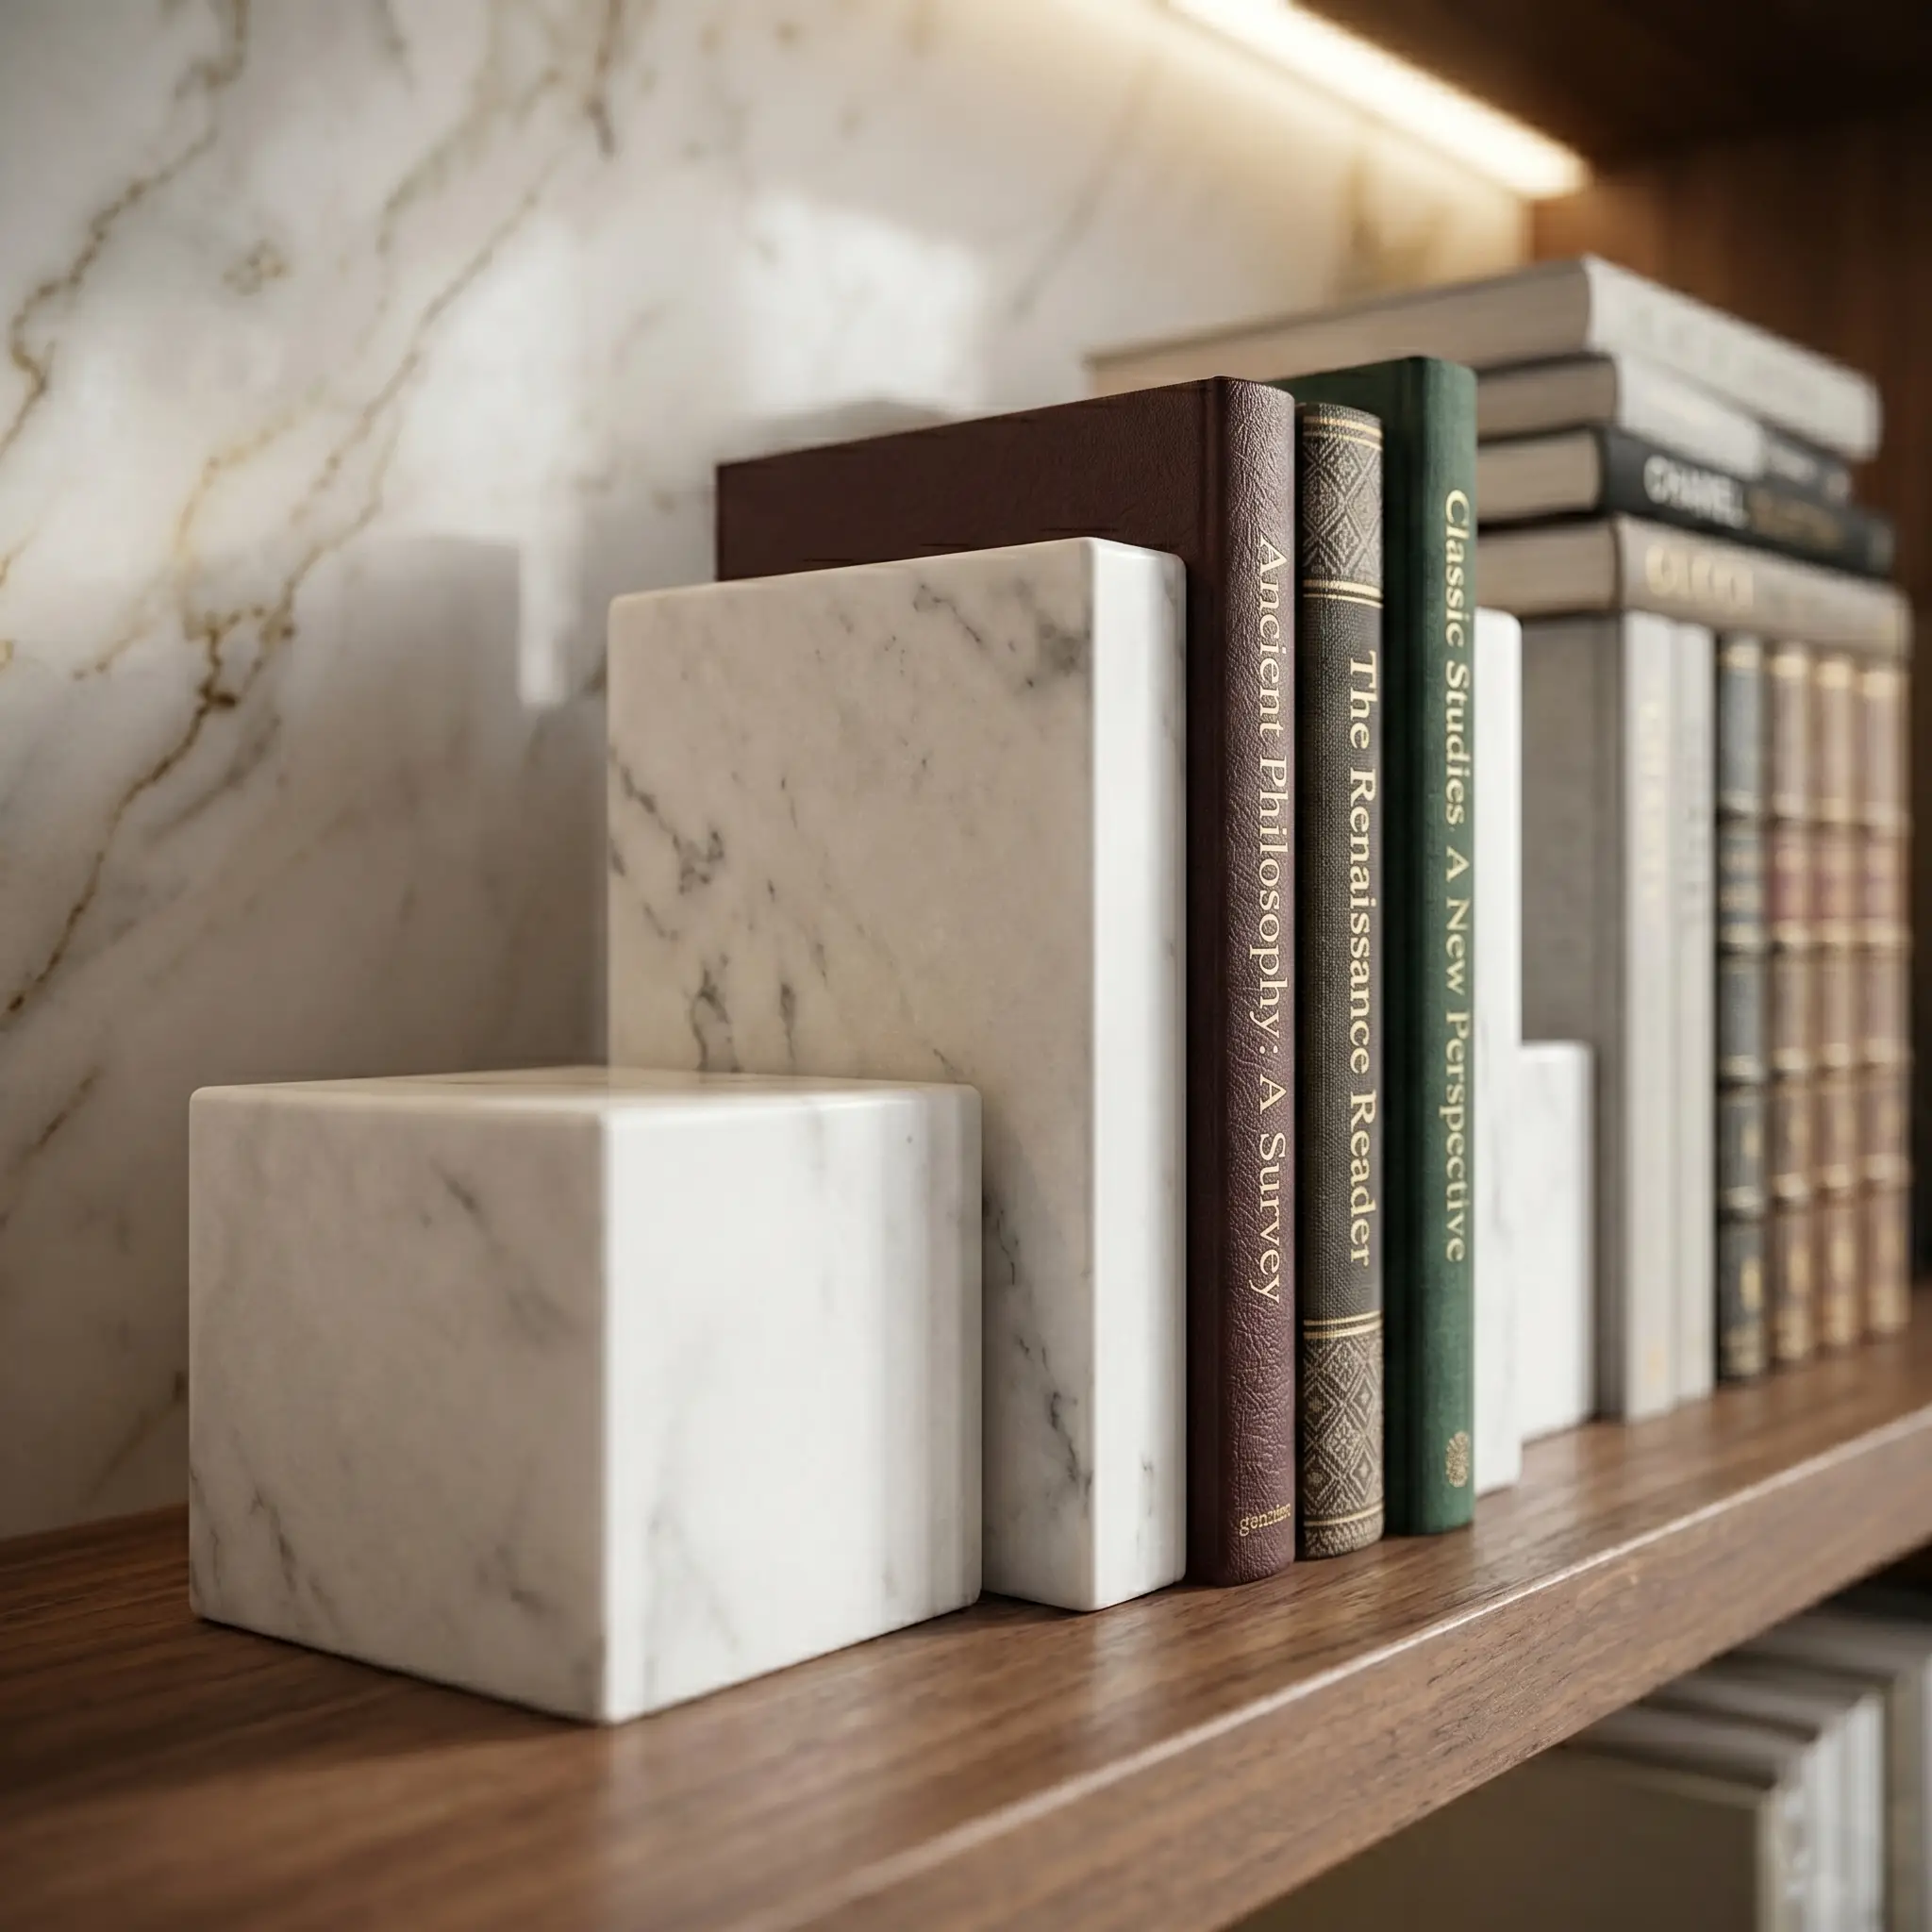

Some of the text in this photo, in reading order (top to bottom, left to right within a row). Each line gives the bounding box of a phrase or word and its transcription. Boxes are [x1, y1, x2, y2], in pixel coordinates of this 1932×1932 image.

[1445, 490, 1471, 647] Classic
[1250, 537, 1288, 1302] Ancient Philosophy: A Survey
[1350, 651, 1378, 1267] The Renaissance Reader
[1445, 845, 1470, 883] A
[1445, 897, 1470, 996] New
[1440, 1009, 1471, 1262] Perspective
